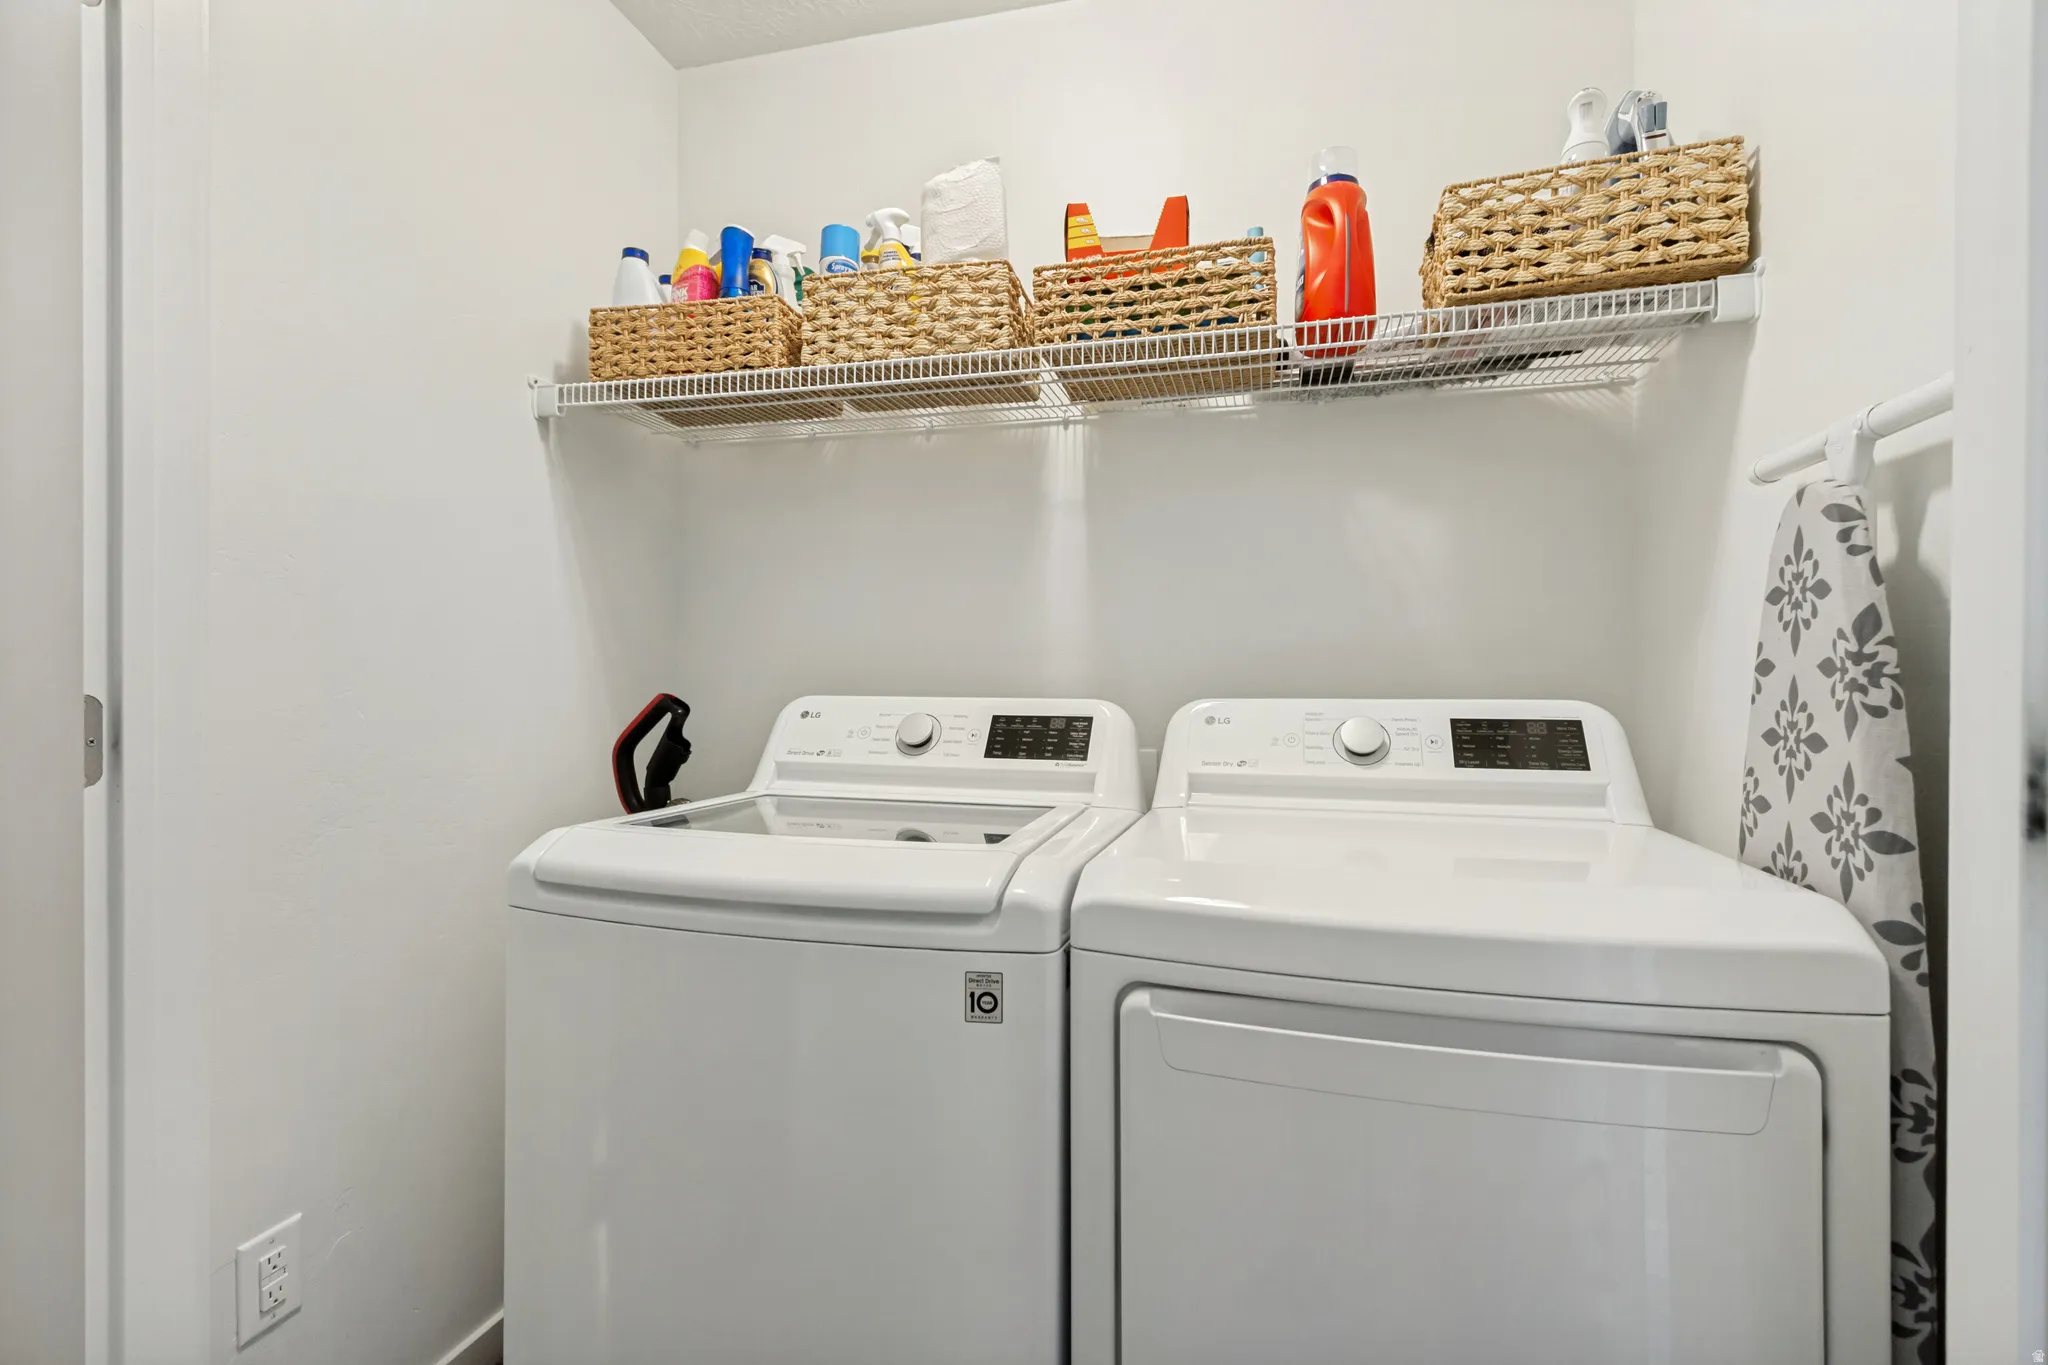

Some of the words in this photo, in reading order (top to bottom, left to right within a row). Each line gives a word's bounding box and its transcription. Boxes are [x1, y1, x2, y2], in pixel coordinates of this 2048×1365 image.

[810, 711, 822, 719] LG
[1217, 717, 1231, 725] LG
[969, 991, 999, 1014] 10
